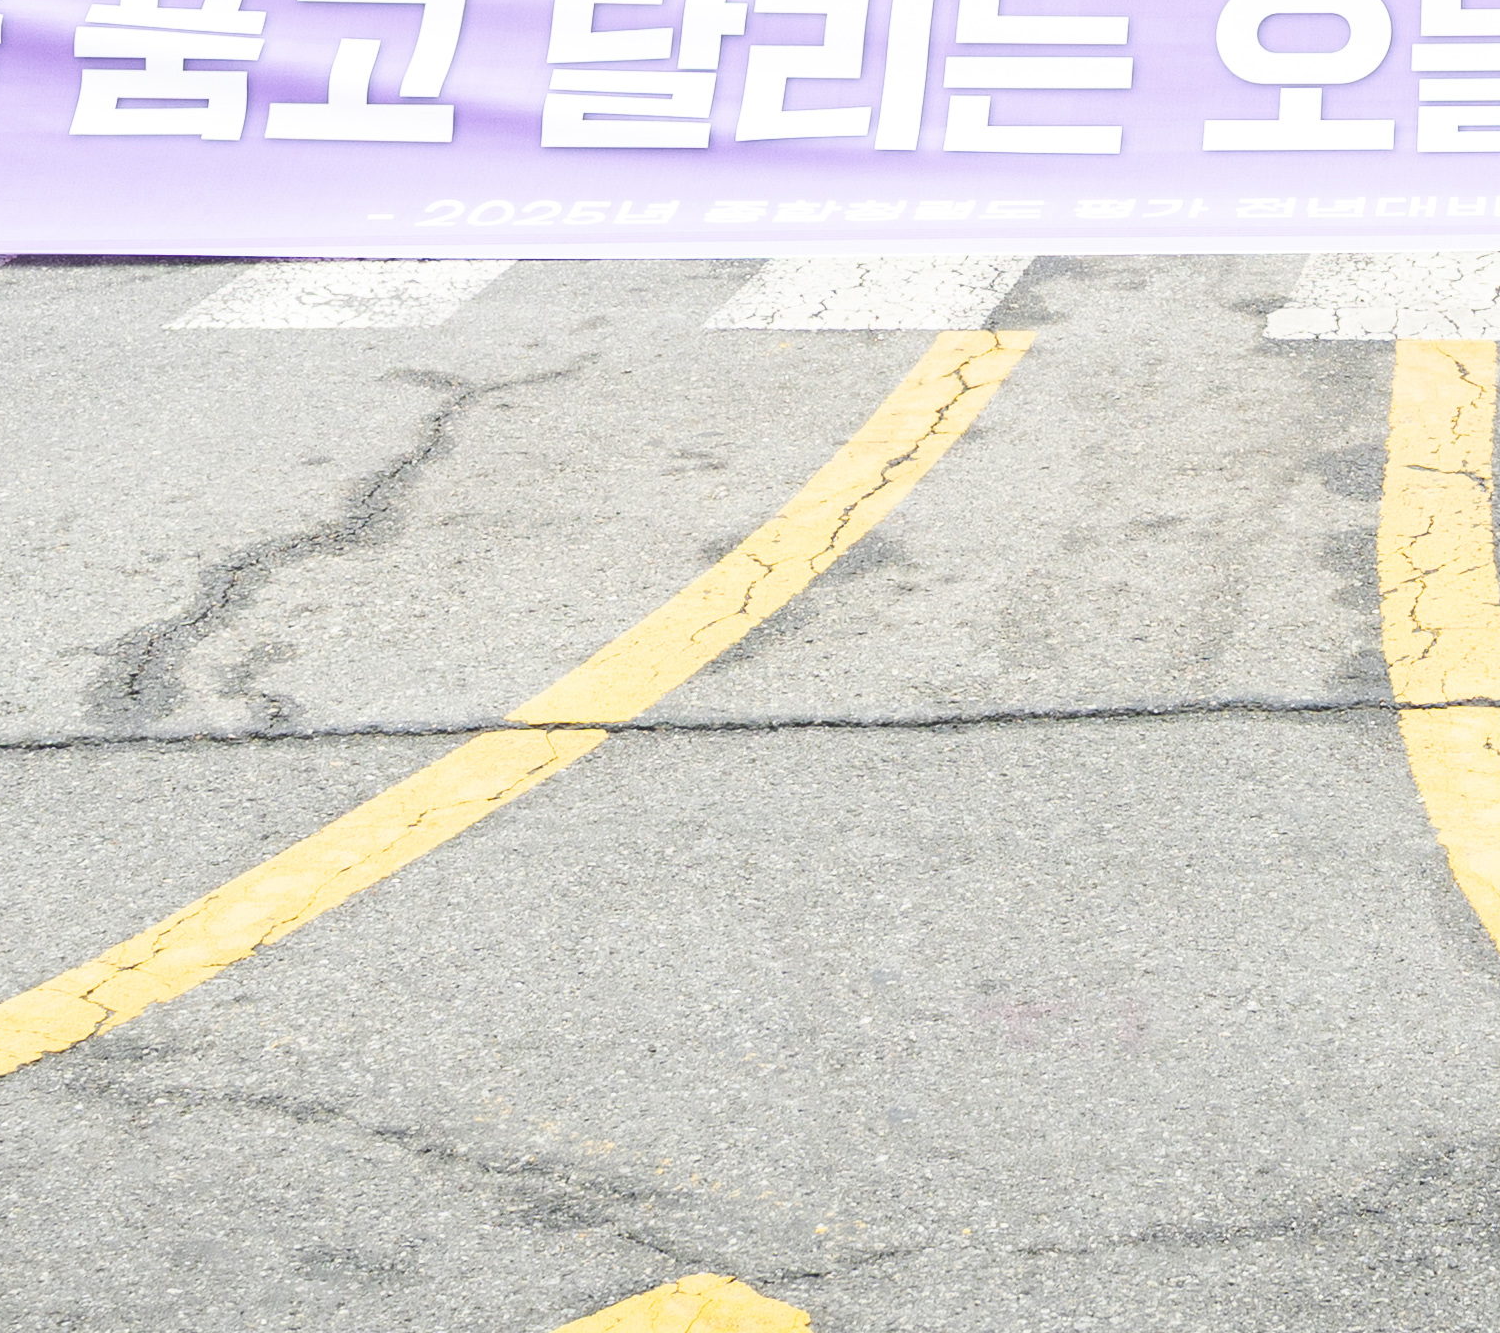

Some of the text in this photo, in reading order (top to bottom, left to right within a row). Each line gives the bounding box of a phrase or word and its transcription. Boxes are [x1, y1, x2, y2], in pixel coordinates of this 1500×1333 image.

[412, 198, 681, 227] 2025년
[702, 198, 1044, 224] 종합청렴도
[1072, 197, 1211, 220] 평가
